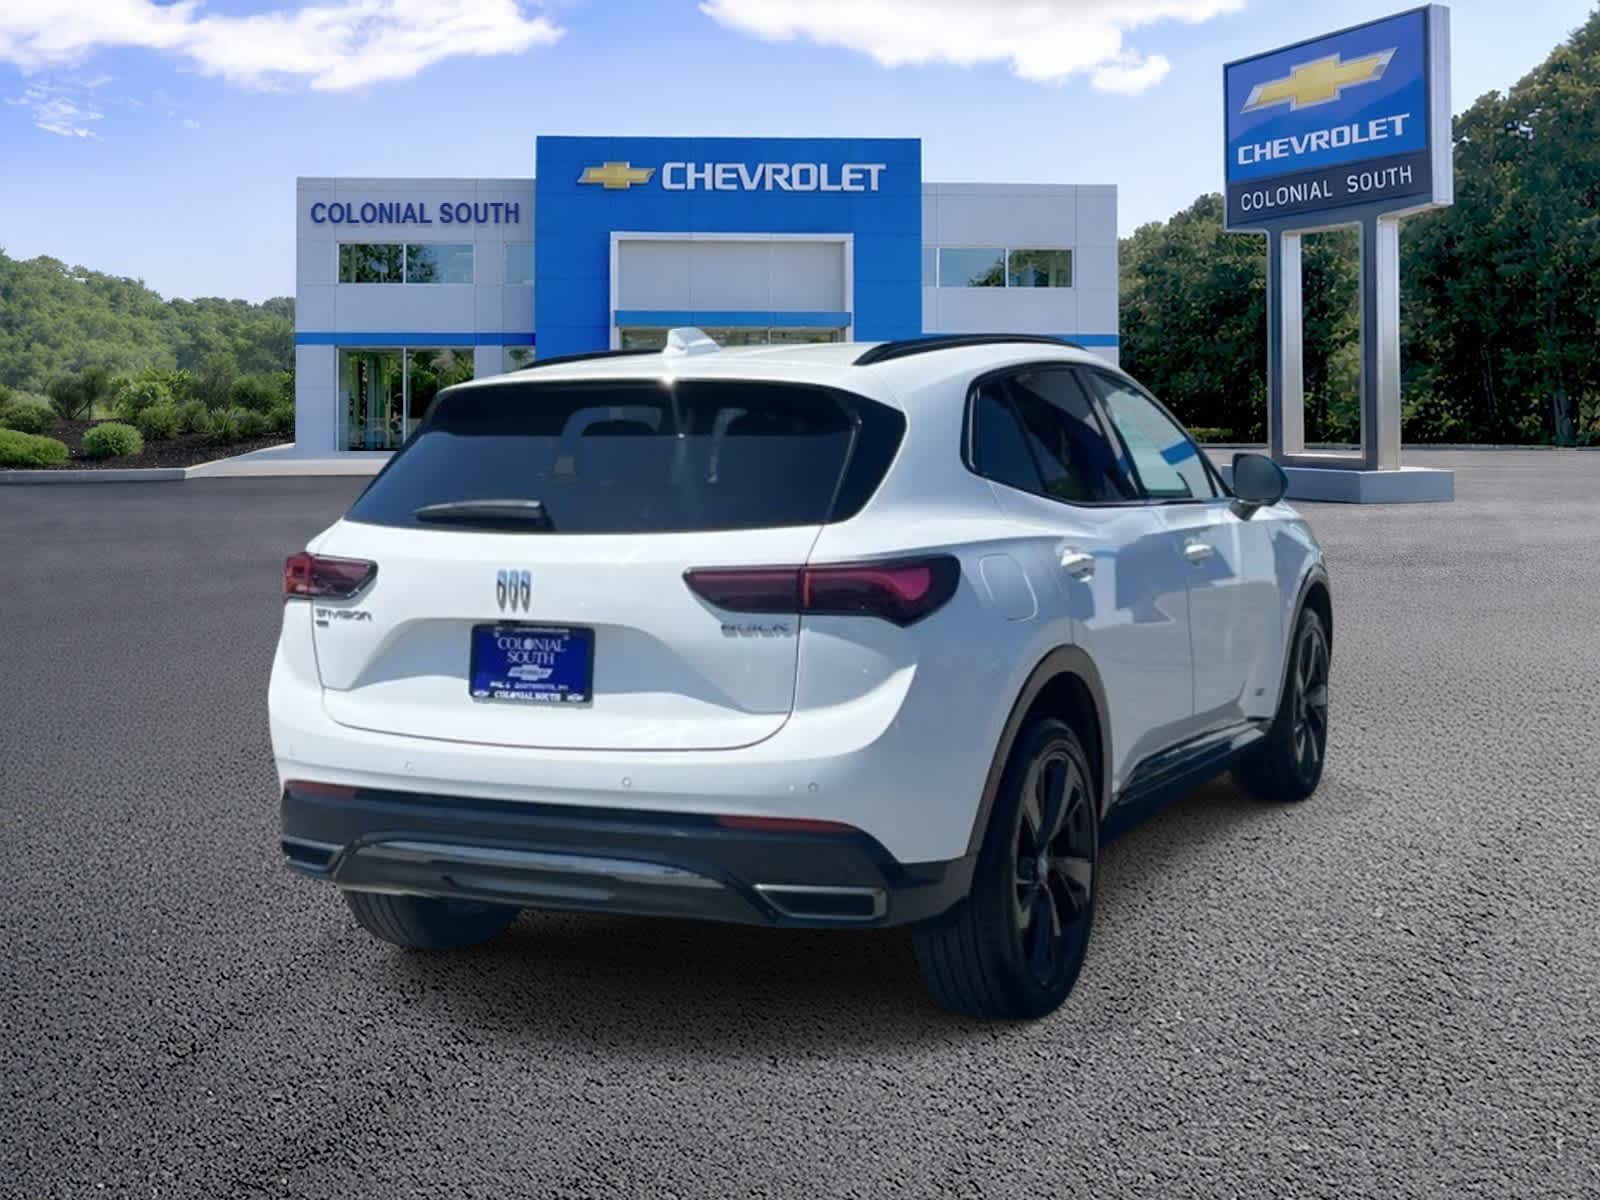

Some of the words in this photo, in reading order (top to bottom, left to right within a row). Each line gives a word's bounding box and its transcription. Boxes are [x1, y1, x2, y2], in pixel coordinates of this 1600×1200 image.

[1237, 113, 1410, 165] CHEVROLET
[662, 162, 887, 192] CHEVROLET
[1241, 179, 1333, 211] COLONIAL
[1346, 165, 1412, 193] SOUTH
[310, 202, 433, 224] COLONIAL
[439, 202, 520, 224] SOUTH
[497, 637, 567, 652] COLONIAL
[507, 651, 555, 665] SOUTH
